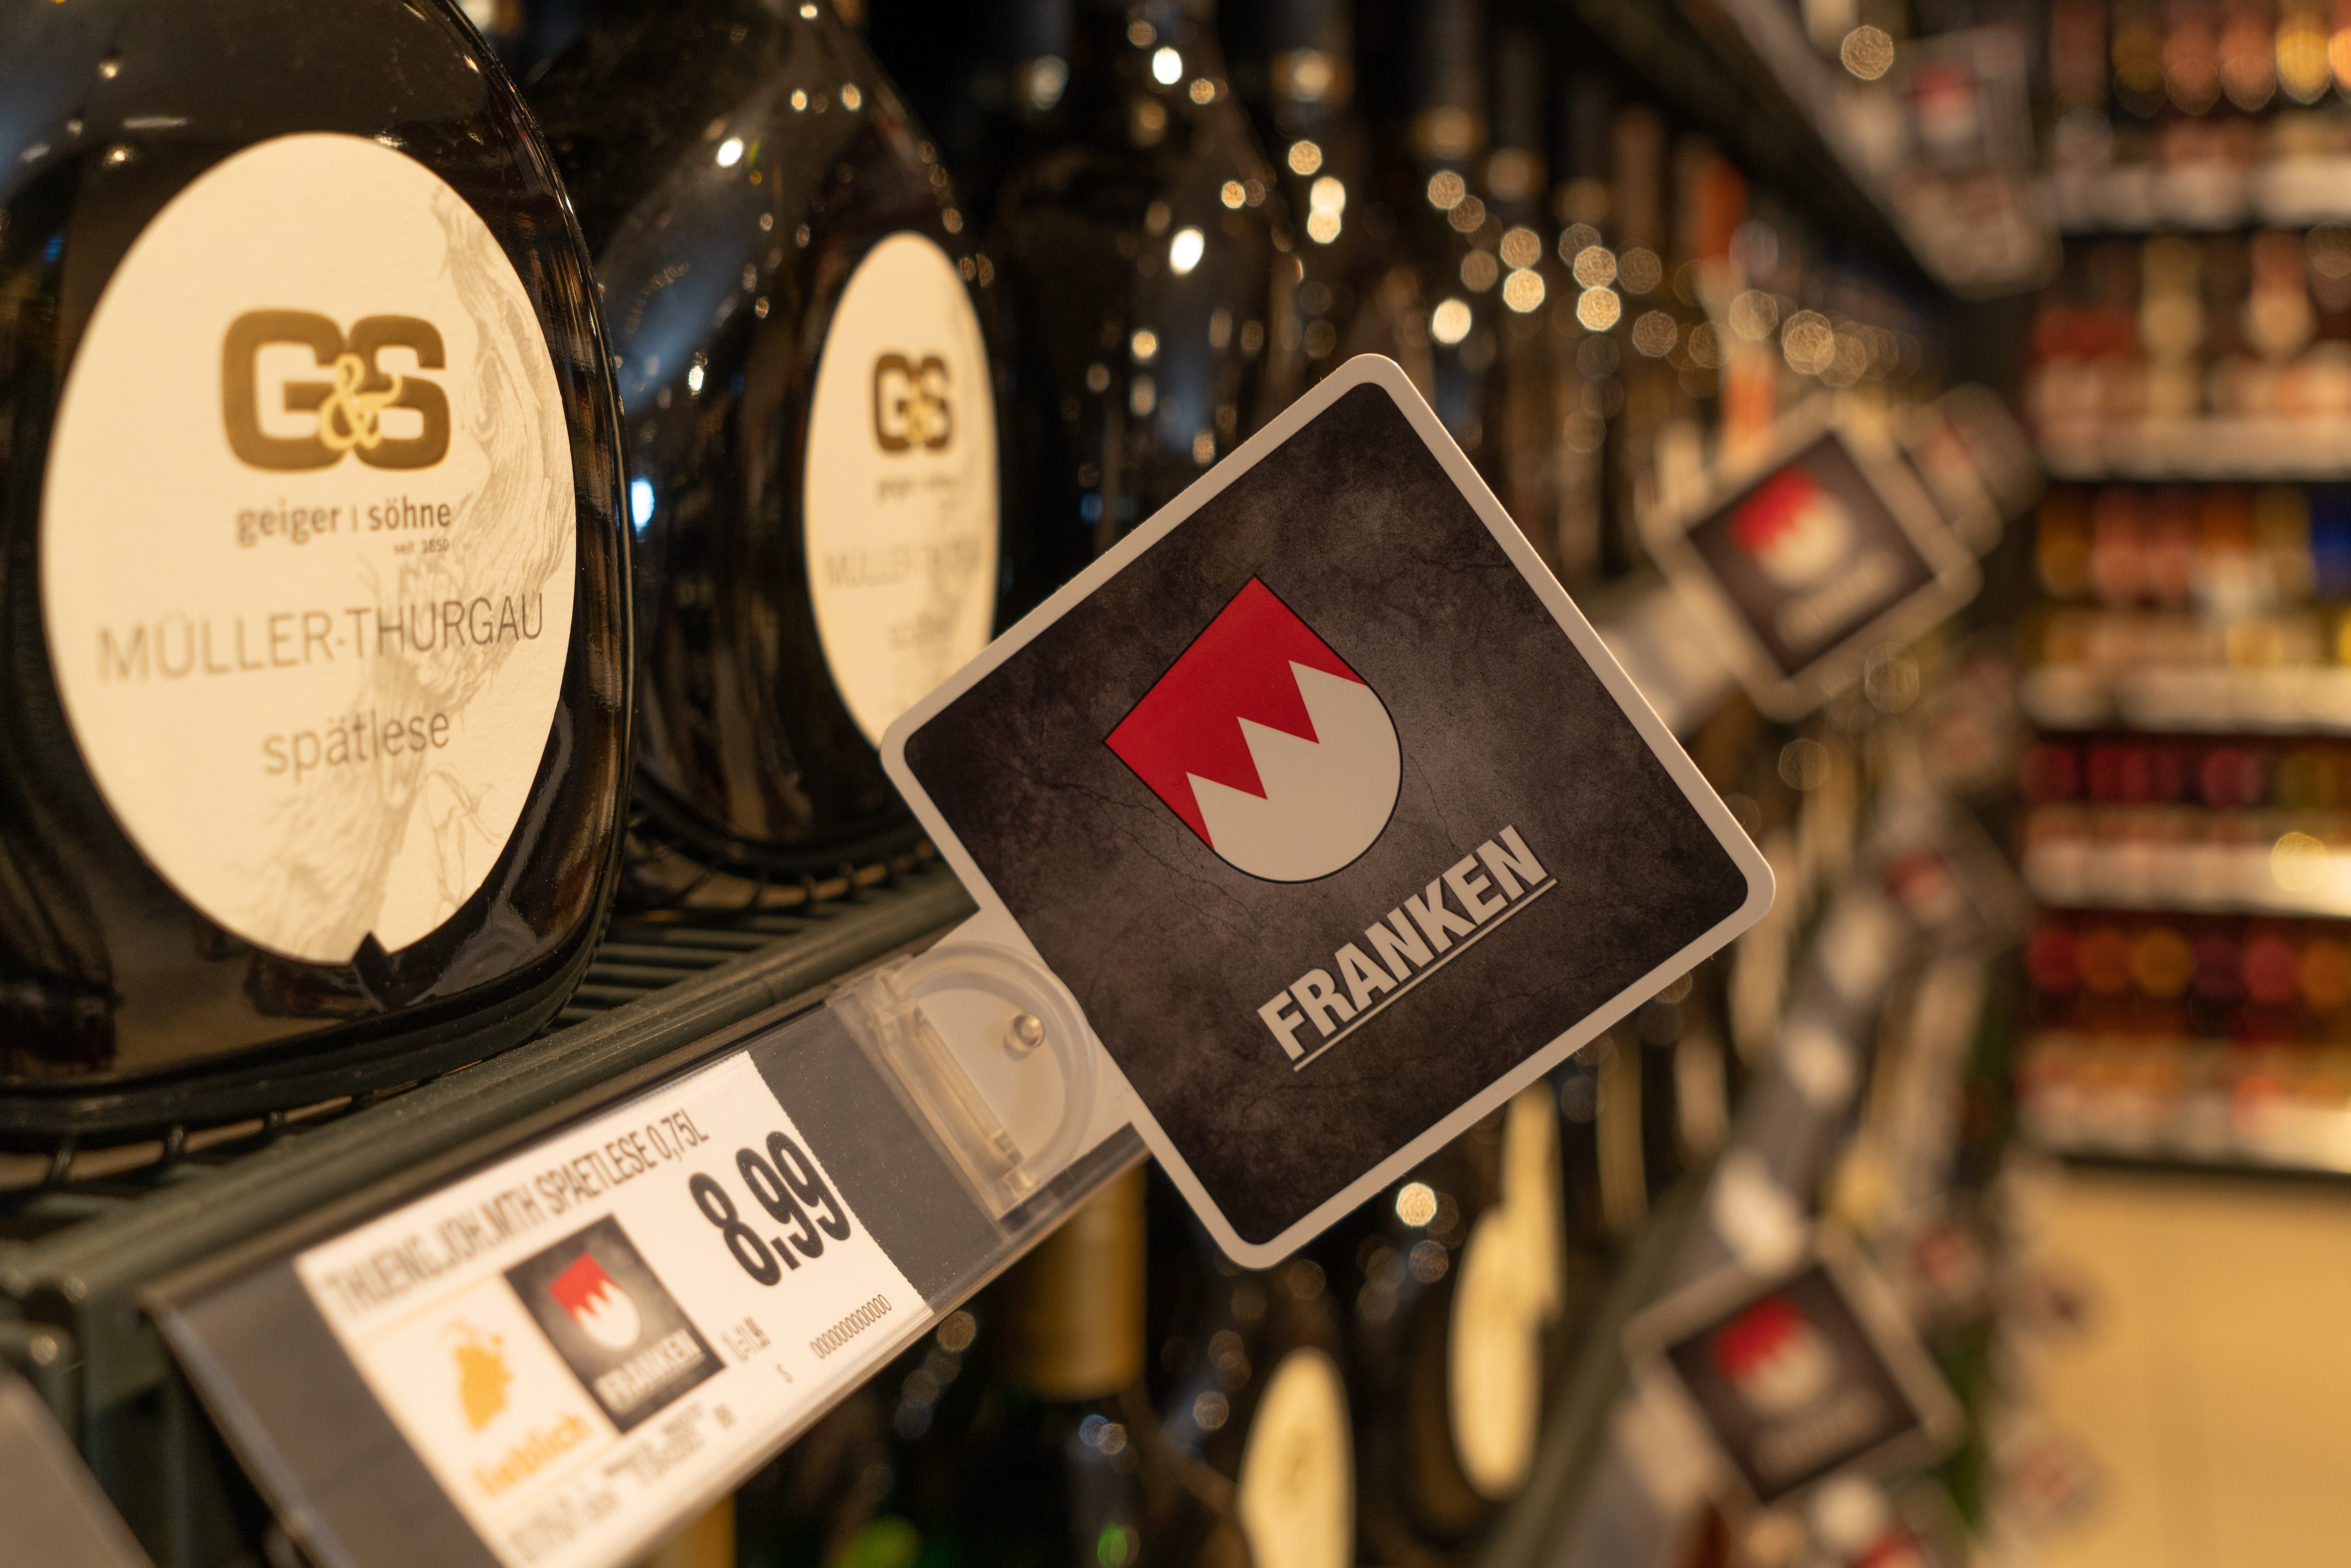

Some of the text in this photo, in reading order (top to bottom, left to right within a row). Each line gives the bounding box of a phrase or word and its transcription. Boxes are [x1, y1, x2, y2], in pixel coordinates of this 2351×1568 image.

[221, 308, 451, 473] G&S
[237, 496, 342, 548] geiger
[368, 494, 451, 532] söhne
[262, 708, 450, 785] spätlese
[1256, 824, 1550, 1064] FRANKEN
[535, 1131, 657, 1215] SPAETLESE
[647, 1108, 710, 1162] 0,75L
[688, 1130, 852, 1286] 8.99
[594, 1328, 702, 1410] FRANKEN
